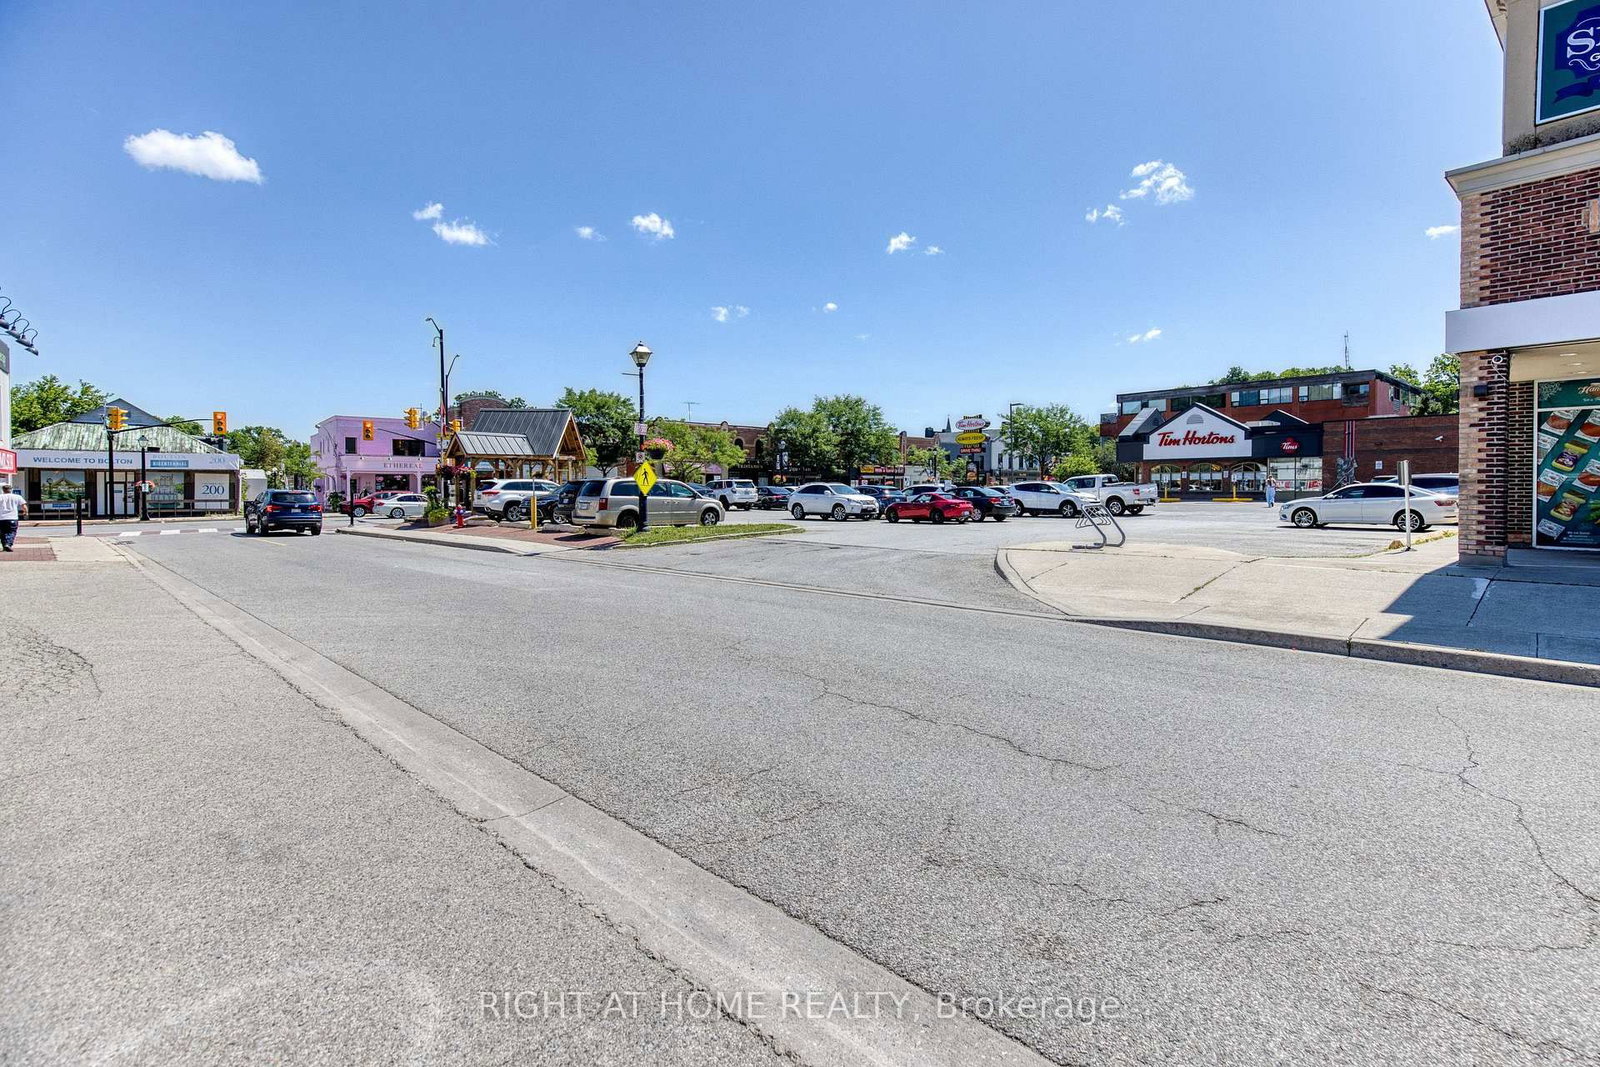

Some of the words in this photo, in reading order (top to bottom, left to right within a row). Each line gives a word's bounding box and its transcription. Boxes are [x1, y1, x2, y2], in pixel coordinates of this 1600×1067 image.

[1158, 432, 1181, 447] Tim
[1181, 430, 1235, 446] Hortons
[1282, 441, 1298, 450] Tims
[97, 457, 133, 465] BOTON
[202, 485, 225, 496] 200
